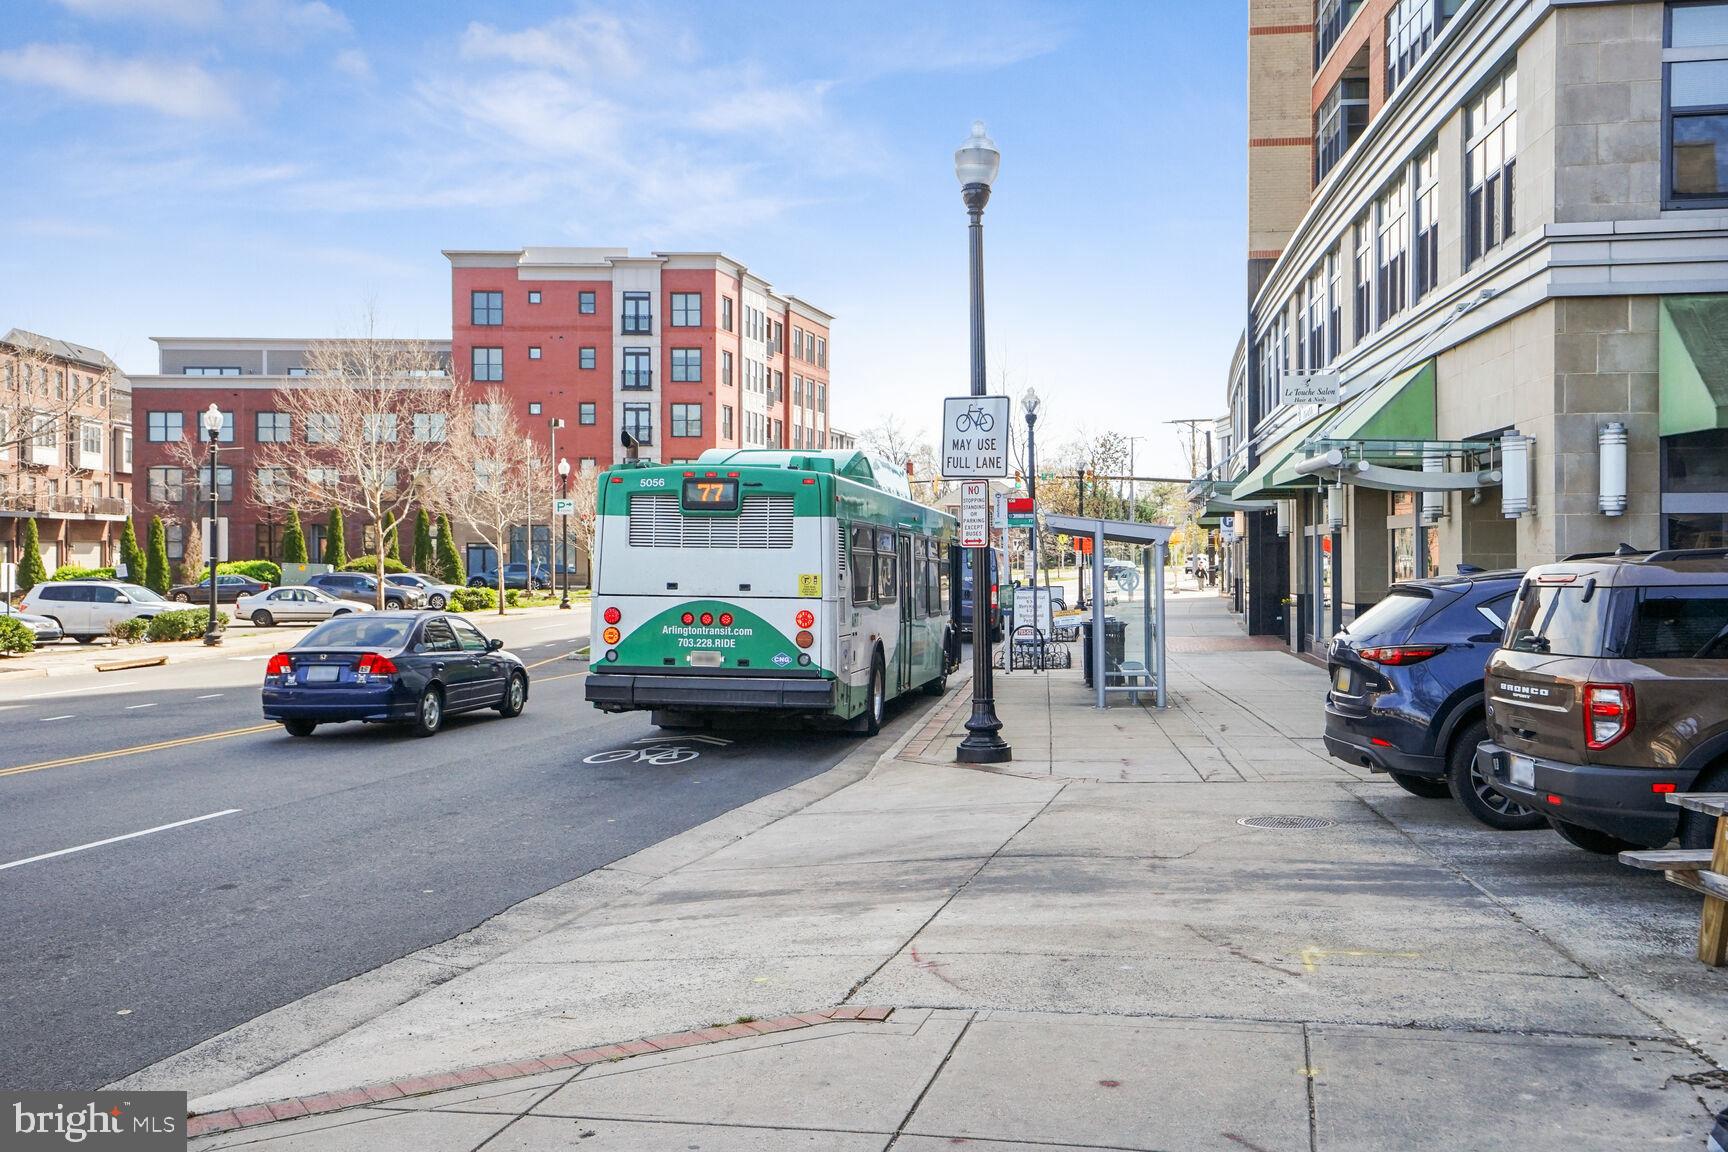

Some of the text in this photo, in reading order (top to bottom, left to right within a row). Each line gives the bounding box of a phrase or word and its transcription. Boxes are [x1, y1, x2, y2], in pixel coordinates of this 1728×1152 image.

[1285, 387, 1336, 396] Le Touche Salon
[952, 438, 997, 451] MAY USE
[946, 456, 1002, 469] FULL LANE
[640, 478, 665, 488] 5056
[697, 483, 724, 502] 77
[968, 485, 980, 495] NO
[557, 501, 566, 512] P
[662, 625, 753, 636] Arlingtontransit.com
[678, 638, 736, 648] 703.228.RIDE
[774, 656, 790, 664] CNG
[1500, 683, 1549, 696] BRONCO
